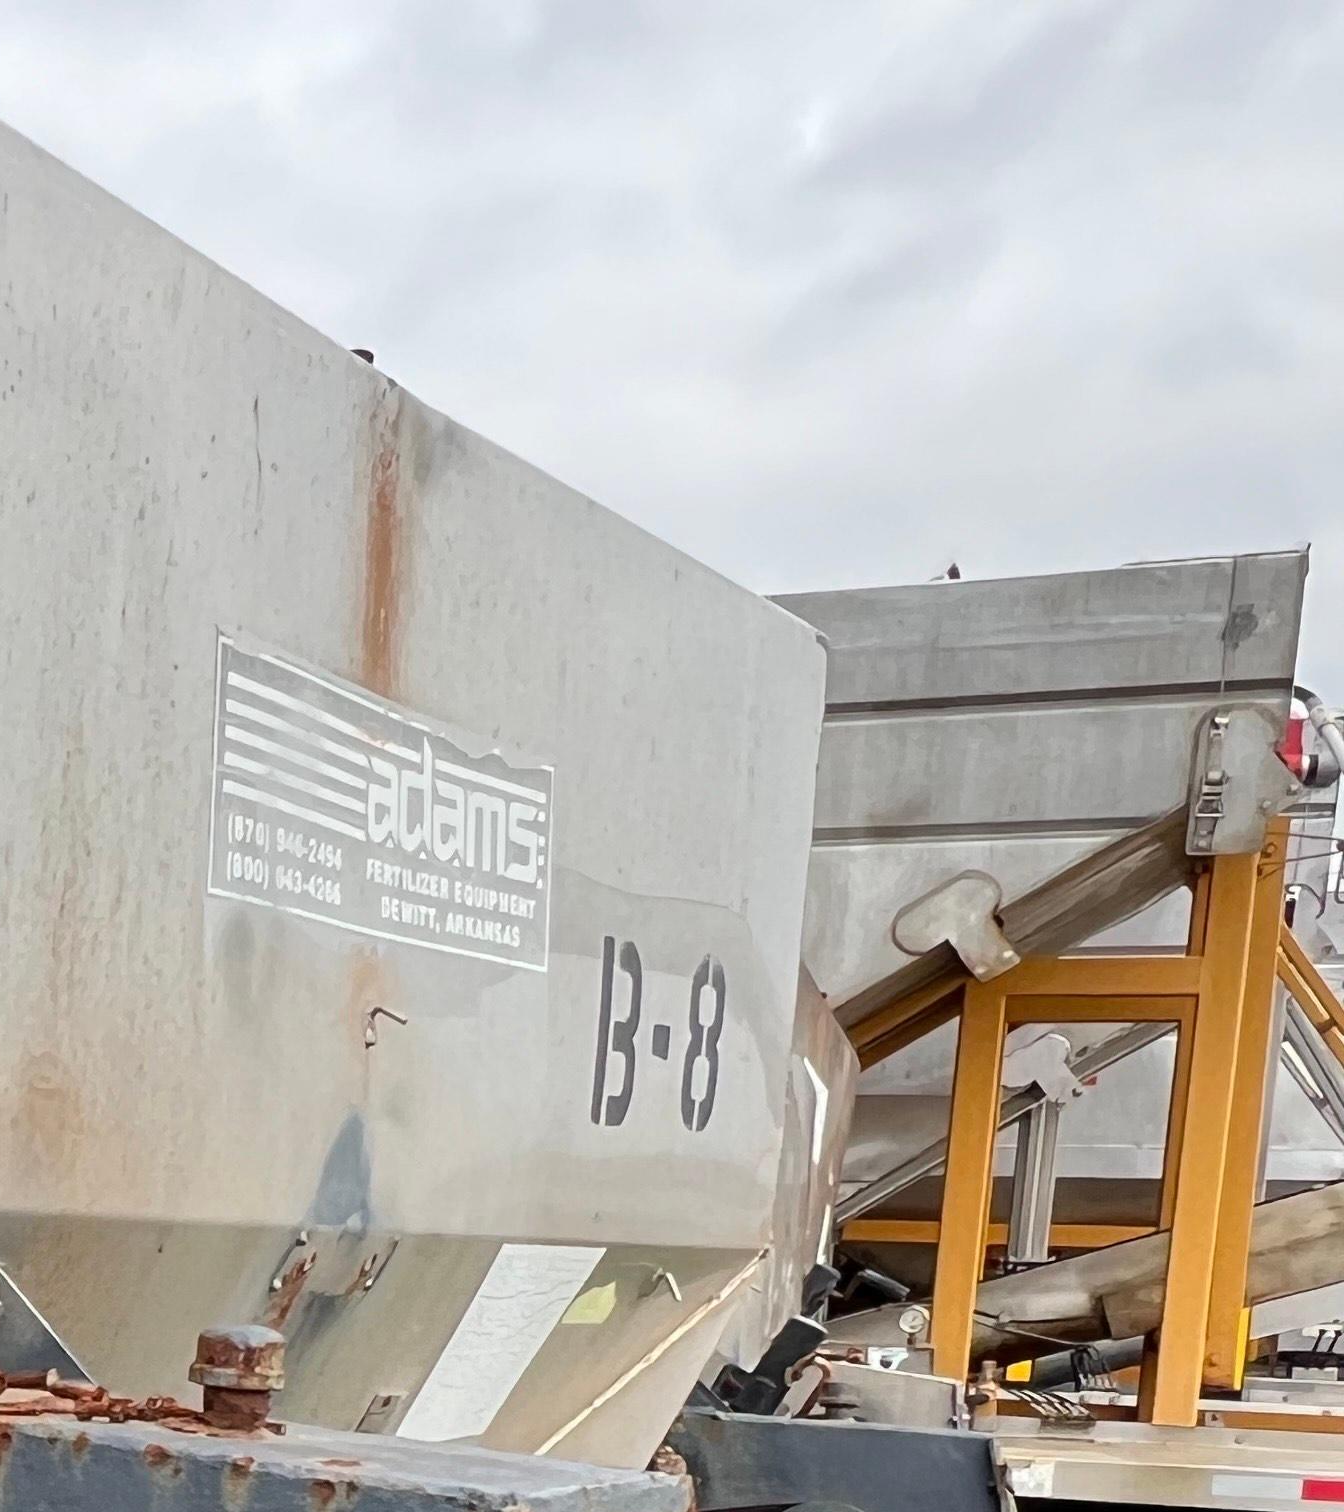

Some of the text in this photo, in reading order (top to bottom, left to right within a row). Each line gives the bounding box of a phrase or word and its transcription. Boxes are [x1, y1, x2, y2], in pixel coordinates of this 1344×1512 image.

[368, 736, 538, 884] adams
[227, 851, 269, 890] (800)
[366, 858, 536, 919] FERTILIZER EQUIPMENT
[381, 896, 520, 948] DEWITT, ARKANSAS
[591, 935, 726, 1132] B-8
